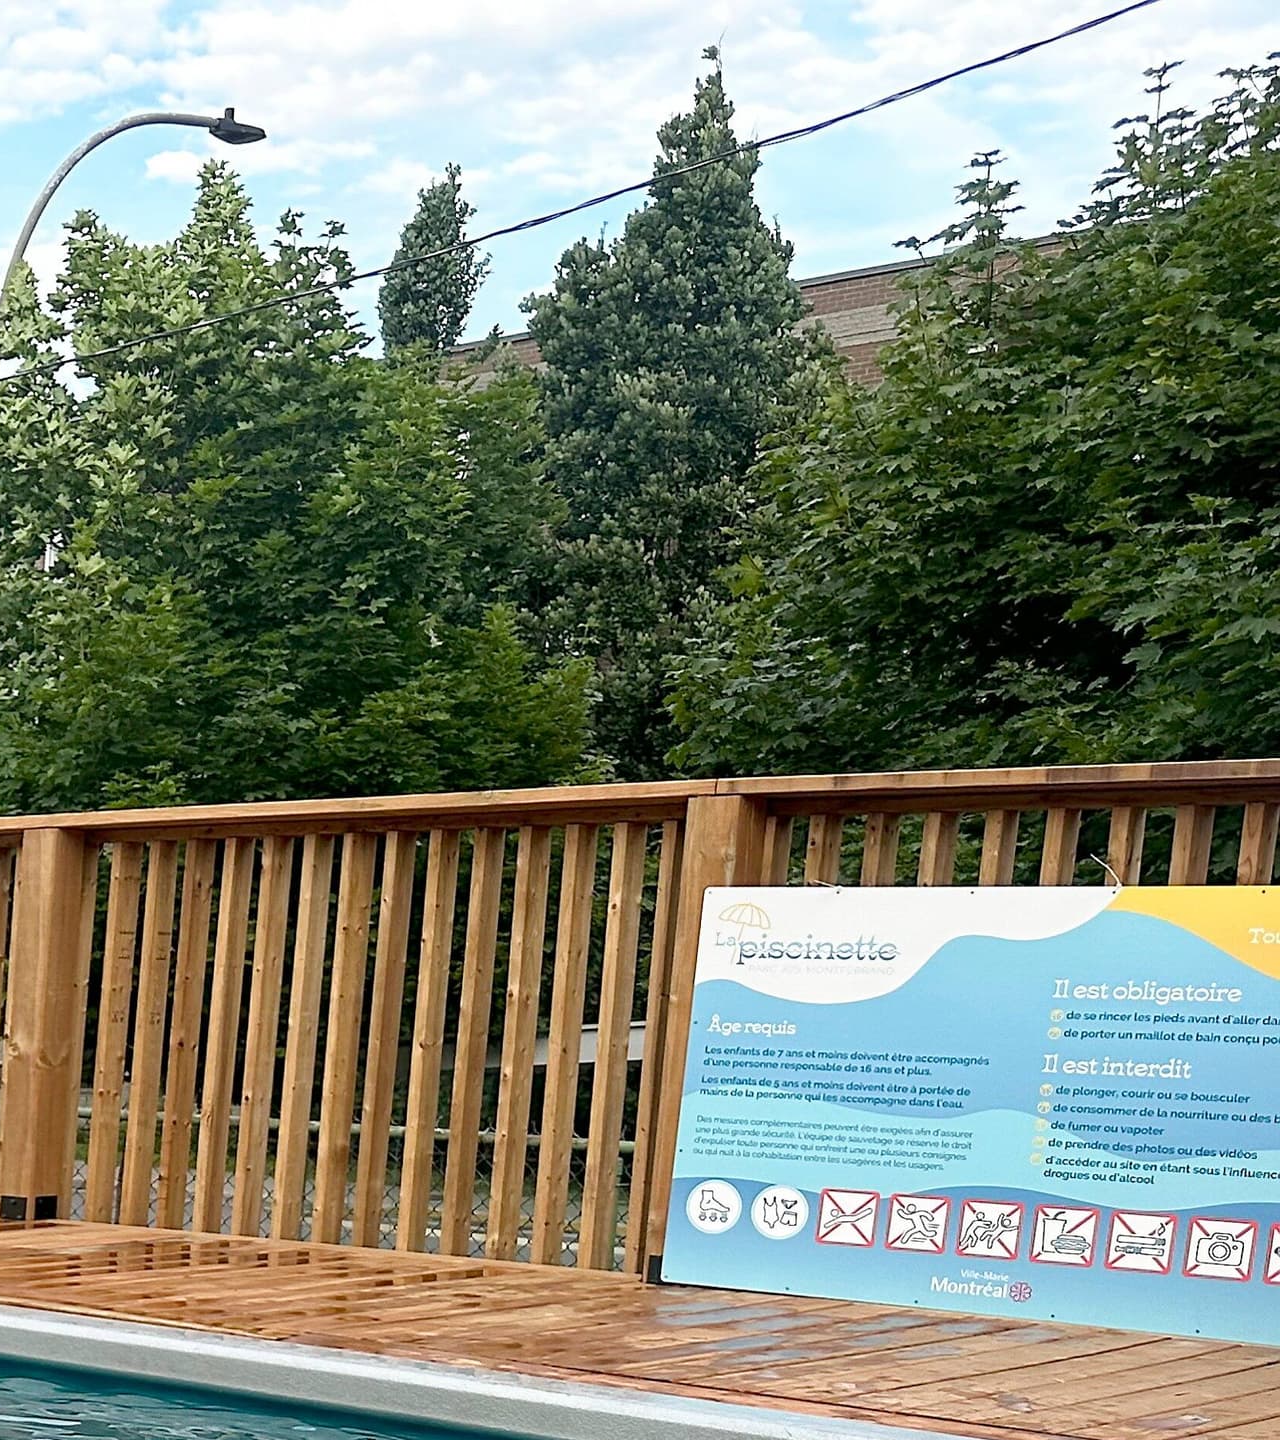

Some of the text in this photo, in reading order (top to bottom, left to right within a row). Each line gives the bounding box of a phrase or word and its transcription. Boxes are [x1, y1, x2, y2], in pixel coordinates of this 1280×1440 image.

[715, 931, 898, 964] La piscinette
[1053, 979, 1242, 1005] Il est obligatoire
[707, 1014, 796, 1036] Âge requis
[1066, 1011, 1081, 1020] de
[1084, 1012, 1097, 1020] se
[1099, 1012, 1132, 1021] rincer
[1134, 1012, 1150, 1022] les
[1153, 1013, 1185, 1024] pieds
[1188, 1016, 1220, 1024] avant
[1064, 1029, 1078, 1038] de
[1081, 1031, 1115, 1040] porter
[1119, 1032, 1132, 1040] un
[1136, 1031, 1175, 1041] maillot
[1178, 1032, 1193, 1041] de
[1196, 1032, 1221, 1042] bain
[1224, 1035, 1259, 1045] conçu
[705, 1046, 721, 1054] Les
[724, 1046, 760, 1056] enfants
[762, 1048, 775, 1056] de
[778, 1050, 784, 1058] 7
[818, 1050, 848, 1059] moins
[851, 1052, 889, 1061] doivent
[915, 1055, 989, 1066] accompagnés
[732, 1059, 778, 1068] personne
[781, 1062, 841, 1071] responsable
[844, 1064, 857, 1072] de
[895, 1066, 904, 1074] et
[907, 1066, 932, 1076] plus.
[1042, 1054, 1192, 1079] Il est interdit
[702, 1075, 718, 1084] Les
[720, 1076, 756, 1086] enfants
[759, 1078, 772, 1086] de
[774, 1080, 779, 1088] 5
[814, 1081, 844, 1090] moins
[846, 1082, 884, 1091] doivent
[919, 1085, 954, 1095] portée
[957, 1087, 970, 1096] de
[1056, 1086, 1250, 1103] de plonger, courir ou se bousculer
[700, 1088, 728, 1096] mains
[730, 1088, 743, 1096] de
[745, 1089, 754, 1097] la
[756, 1091, 802, 1100] personne
[805, 1092, 820, 1102] qui
[823, 1093, 837, 1102] les
[840, 1096, 907, 1106] accompagne
[909, 1098, 934, 1107] dans
[1053, 1103, 1068, 1113] de
[1070, 1105, 1136, 1116] consommer
[1139, 1107, 1154, 1117] de
[1157, 1108, 1168, 1117] la
[1170, 1109, 1229, 1121] nourriture
[1232, 1113, 1246, 1122] ou
[1250, 1113, 1271, 1123] des
[1051, 1120, 1164, 1135] de fumer ou vapoter
[1048, 1138, 1257, 1159] de prendre des photos ou des vidéos
[1044, 1170, 1089, 1180] drogues
[1092, 1172, 1107, 1181] ou
[1103, 1160, 1117, 1168] au
[1120, 1160, 1140, 1170] site
[1143, 1163, 1157, 1171] en
[1160, 1162, 1190, 1173] étant
[1193, 1166, 1220, 1175] sous
[961, 1269, 1008, 1282] Ville-Marie
[930, 1276, 1008, 1298] Montréal
